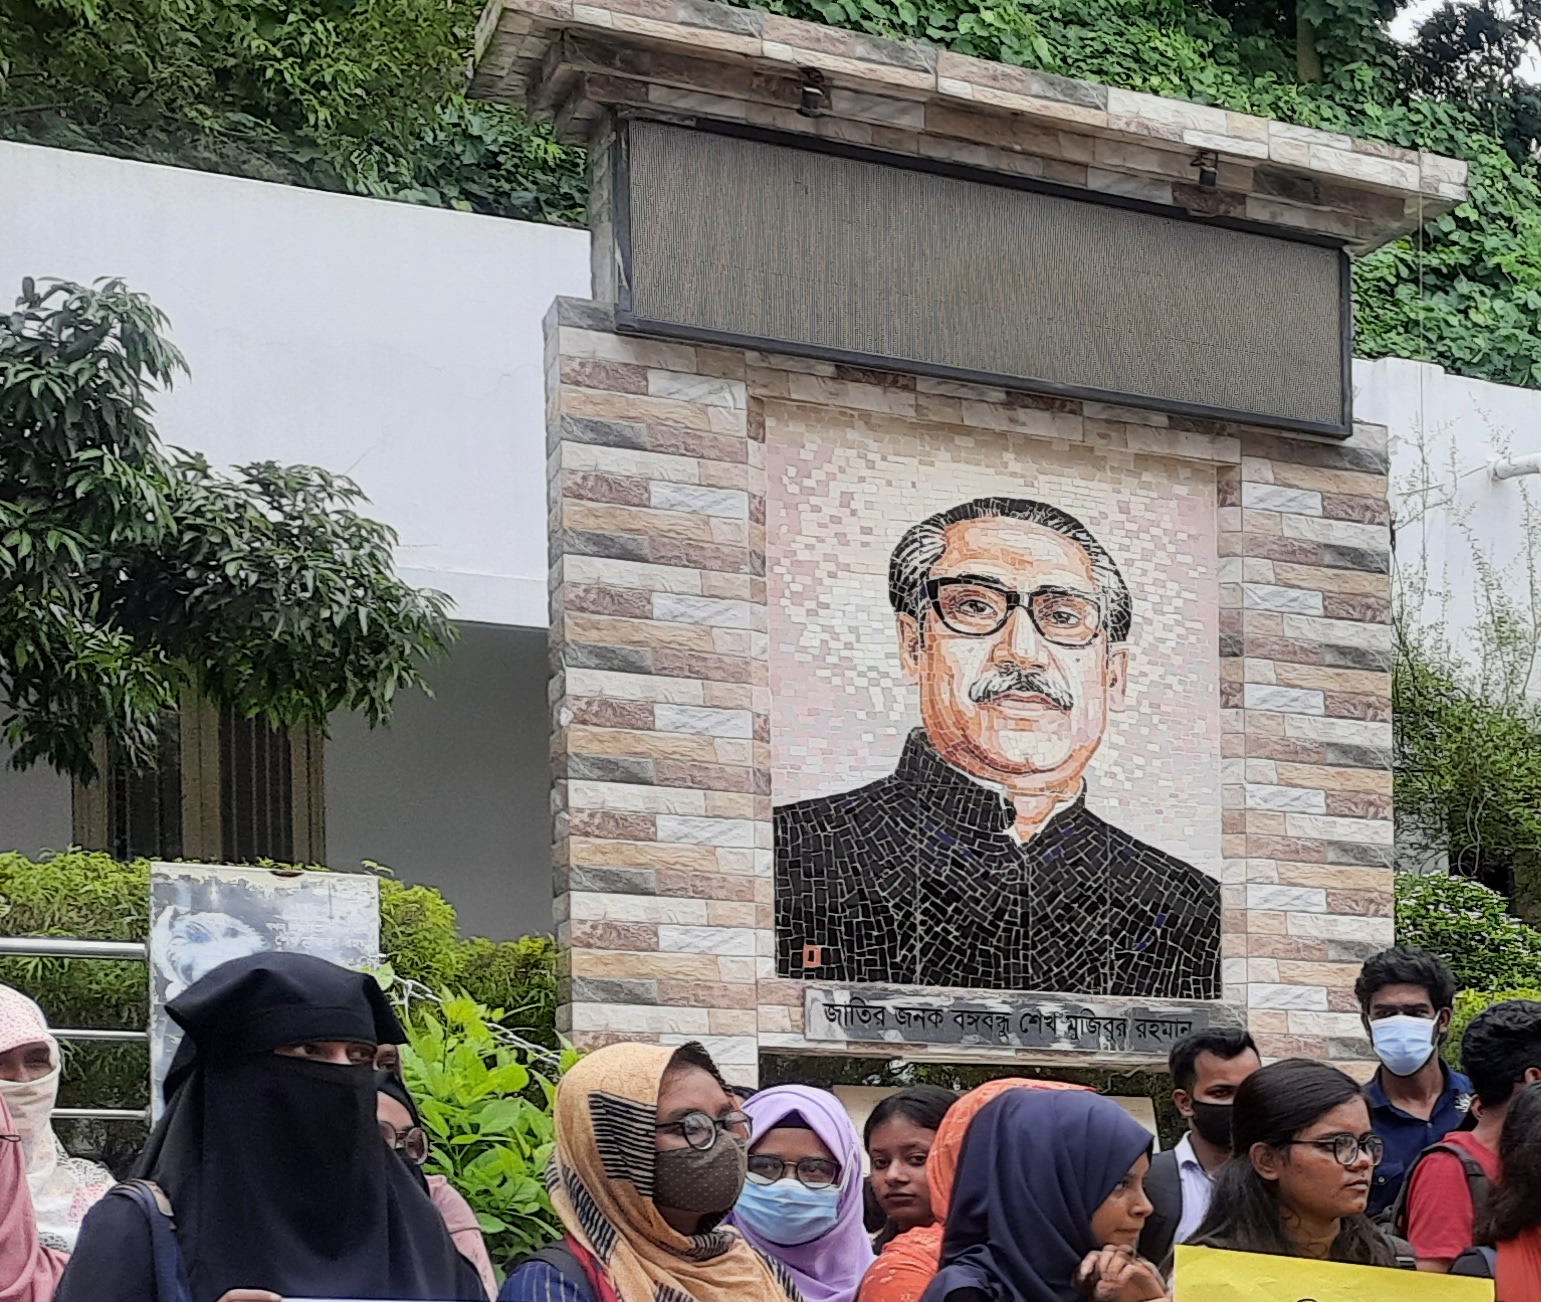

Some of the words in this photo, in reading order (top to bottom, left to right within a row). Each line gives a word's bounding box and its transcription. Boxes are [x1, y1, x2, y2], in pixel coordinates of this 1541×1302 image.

[822, 999, 886, 1028] জাতির
[894, 1006, 943, 1028] জনক
[951, 1009, 1012, 1038] বঙ্গবন্ধু
[1019, 1010, 1057, 1036] শেখ
[1066, 1009, 1129, 1042] মুজিবুর
[1135, 1018, 1193, 1043] রহমান
